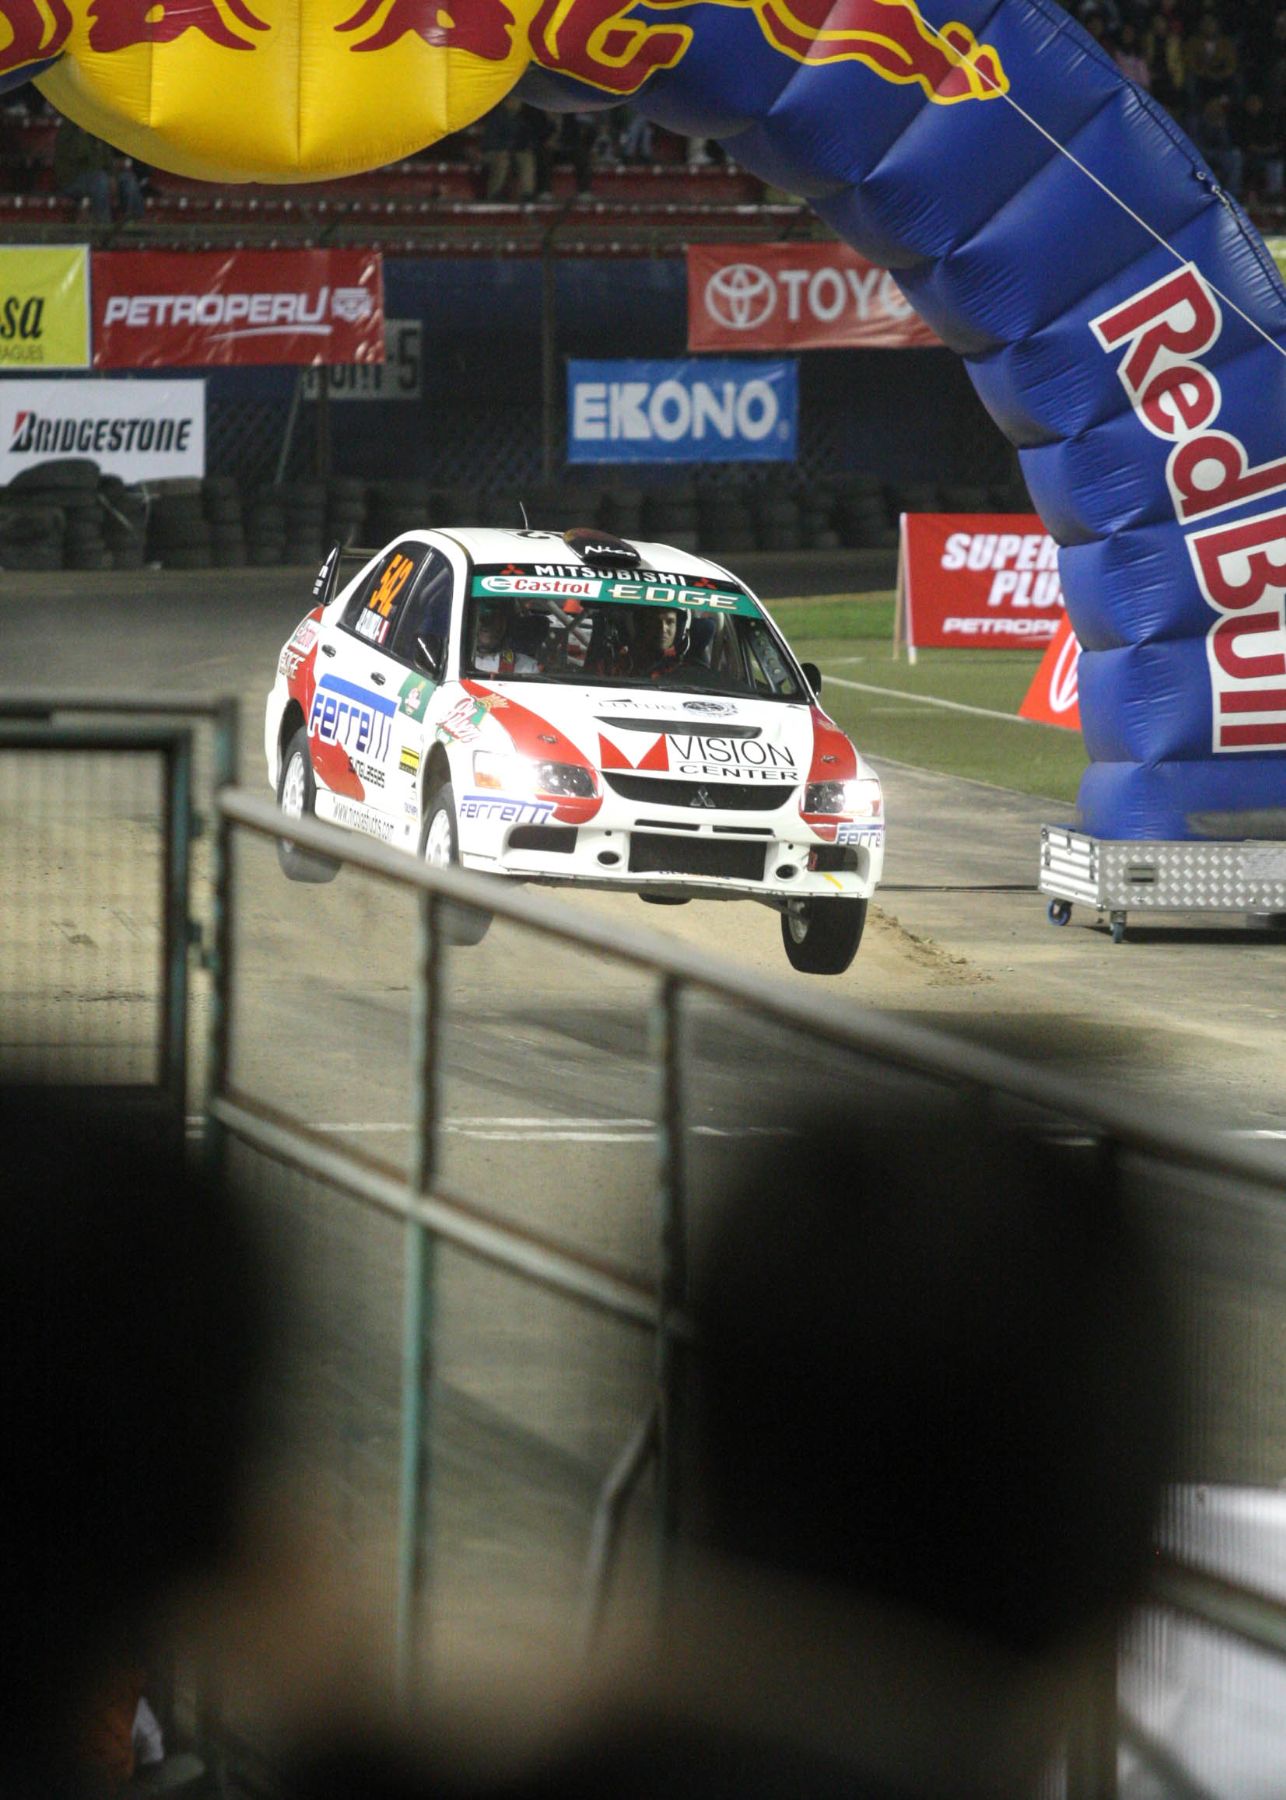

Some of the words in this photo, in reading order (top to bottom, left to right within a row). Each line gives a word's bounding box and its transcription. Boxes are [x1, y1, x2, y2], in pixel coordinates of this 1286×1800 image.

[1088, 261, 1286, 526] Red
[8, 410, 193, 453] BRIDGESTONE
[368, 553, 414, 618] 542
[513, 579, 591, 595] Castrol
[607, 583, 740, 610] EDGE
[534, 564, 688, 588] MITSUBISHI
[986, 569, 1066, 608] PLU
[1184, 506, 1286, 754] Bull
[668, 734, 796, 767] VISION
[679, 764, 800, 781] CENTER
